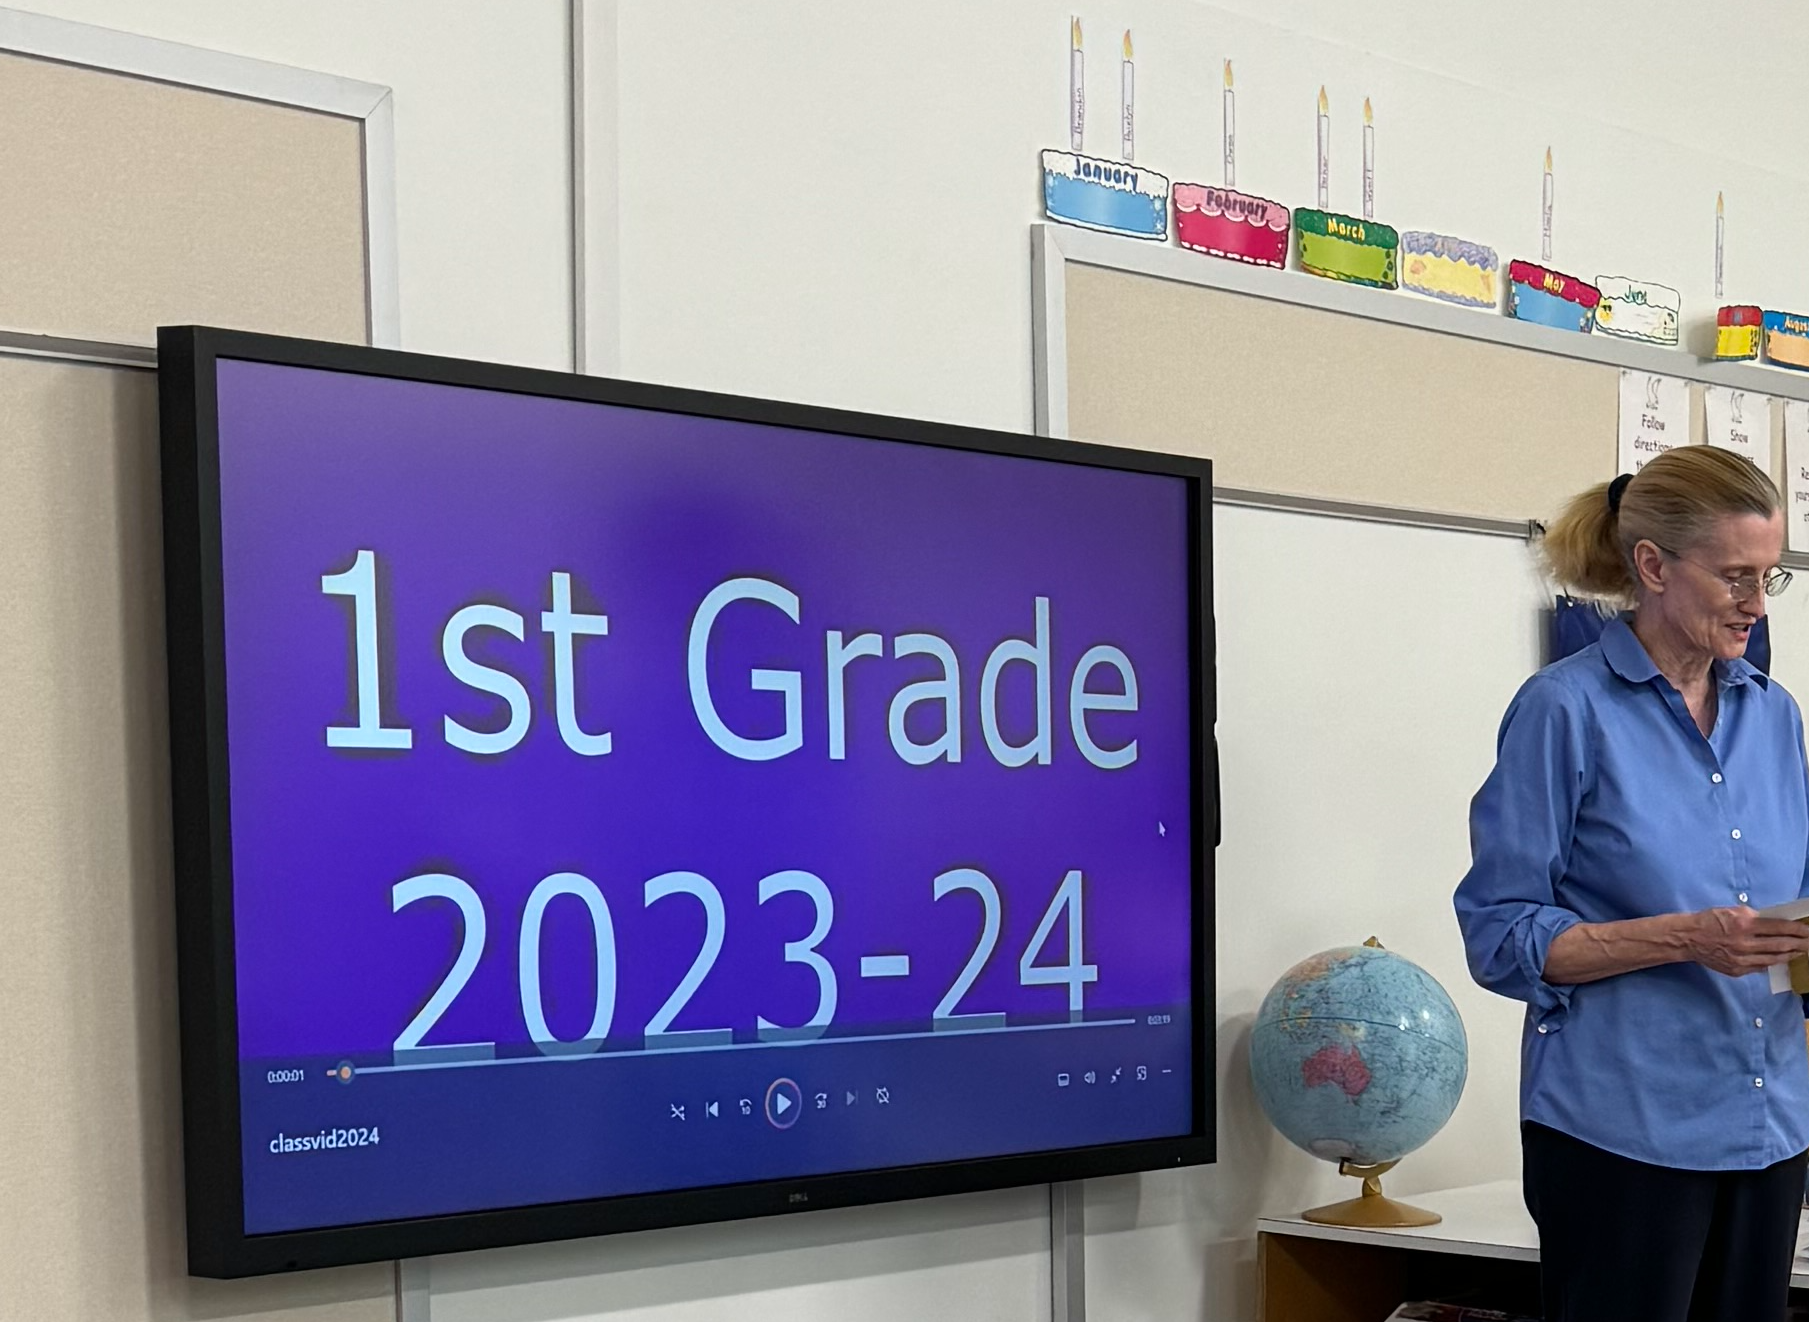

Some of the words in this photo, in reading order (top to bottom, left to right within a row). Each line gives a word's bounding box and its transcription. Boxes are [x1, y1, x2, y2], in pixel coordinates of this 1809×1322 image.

[1074, 156, 1138, 192] January
[1206, 189, 1268, 219] February
[1327, 218, 1365, 241] March
[1543, 272, 1565, 294] May
[1642, 413, 1665, 431] Follow
[1730, 429, 1748, 444] Show
[319, 549, 613, 757] 1st
[685, 576, 1139, 769] Grade
[389, 868, 1099, 1066] 2023-24
[267, 1069, 304, 1083] 0:00:01
[269, 1127, 379, 1153] classvid2024
